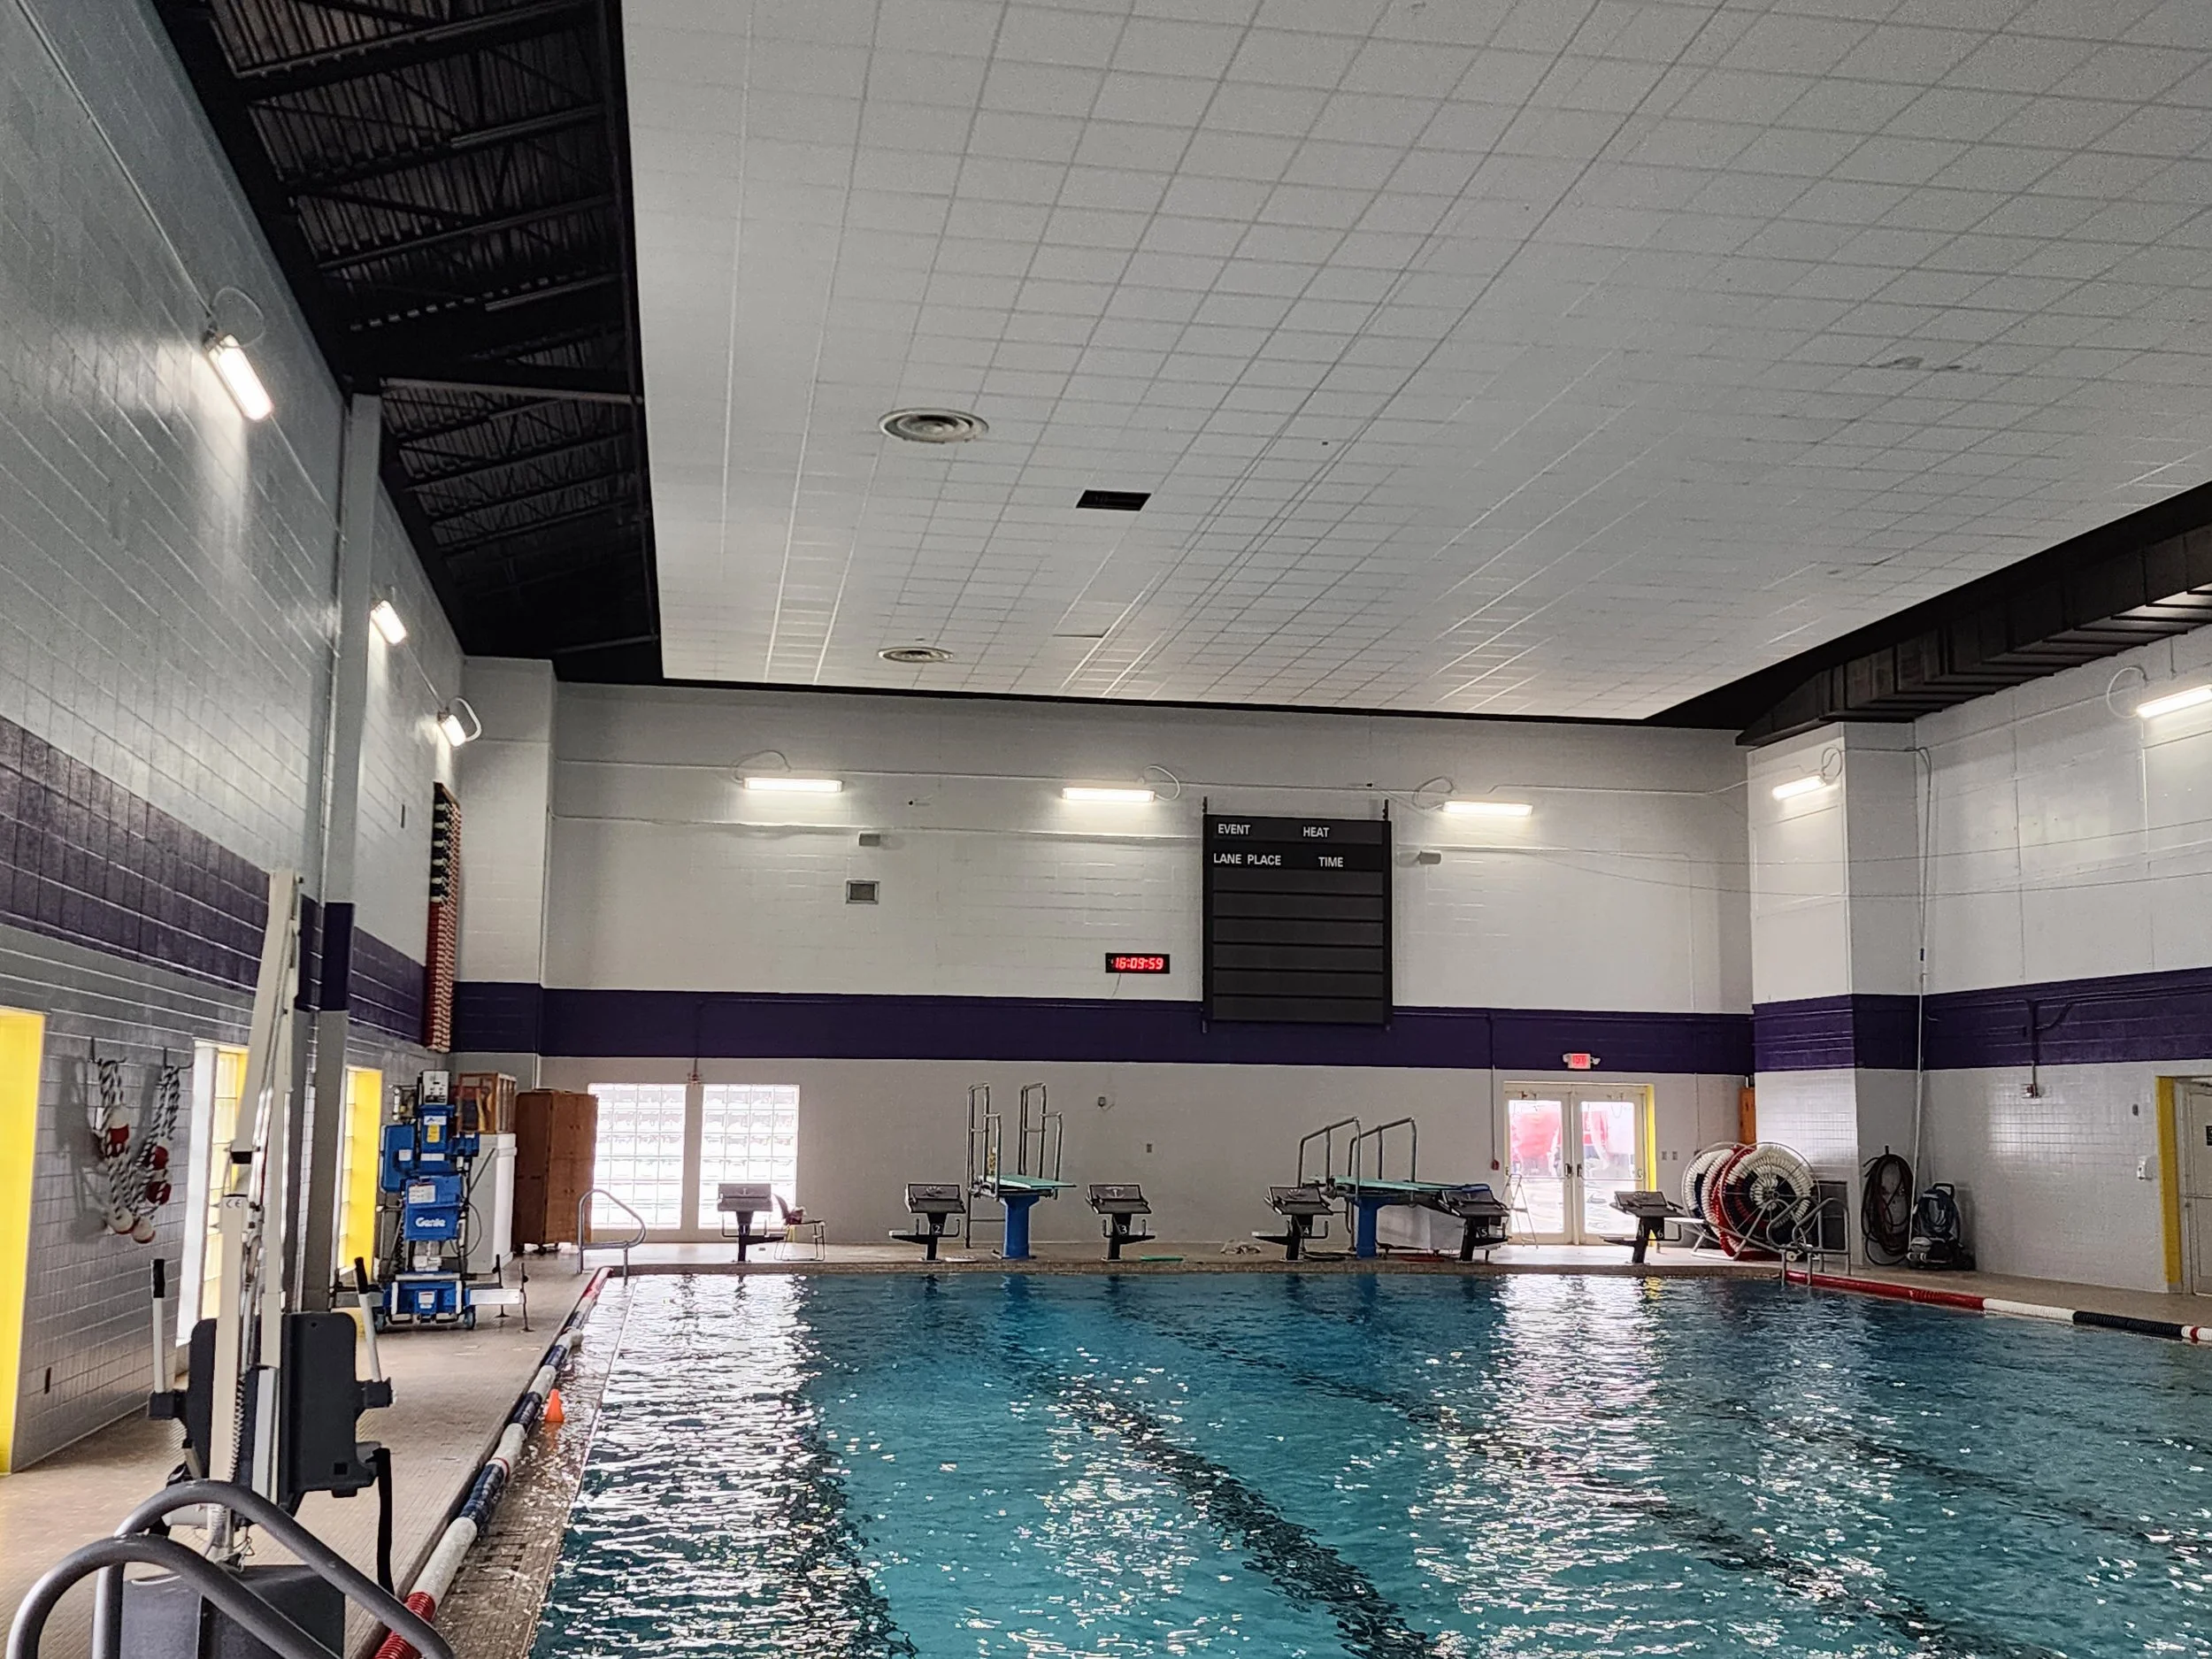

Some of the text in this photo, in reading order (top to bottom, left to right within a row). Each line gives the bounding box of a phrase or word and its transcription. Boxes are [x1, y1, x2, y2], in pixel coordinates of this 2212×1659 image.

[1217, 823, 1330, 838] EVENT HEAT
[1213, 852, 1344, 868] LANE PLACE TIME
[1115, 956, 1164, 970] 16:09:59
[415, 1217, 446, 1227] Genie
[934, 1225, 941, 1233] 2
[1121, 1225, 1127, 1234] 3
[1303, 1226, 1310, 1235] 4
[1656, 1228, 1663, 1238] 6
